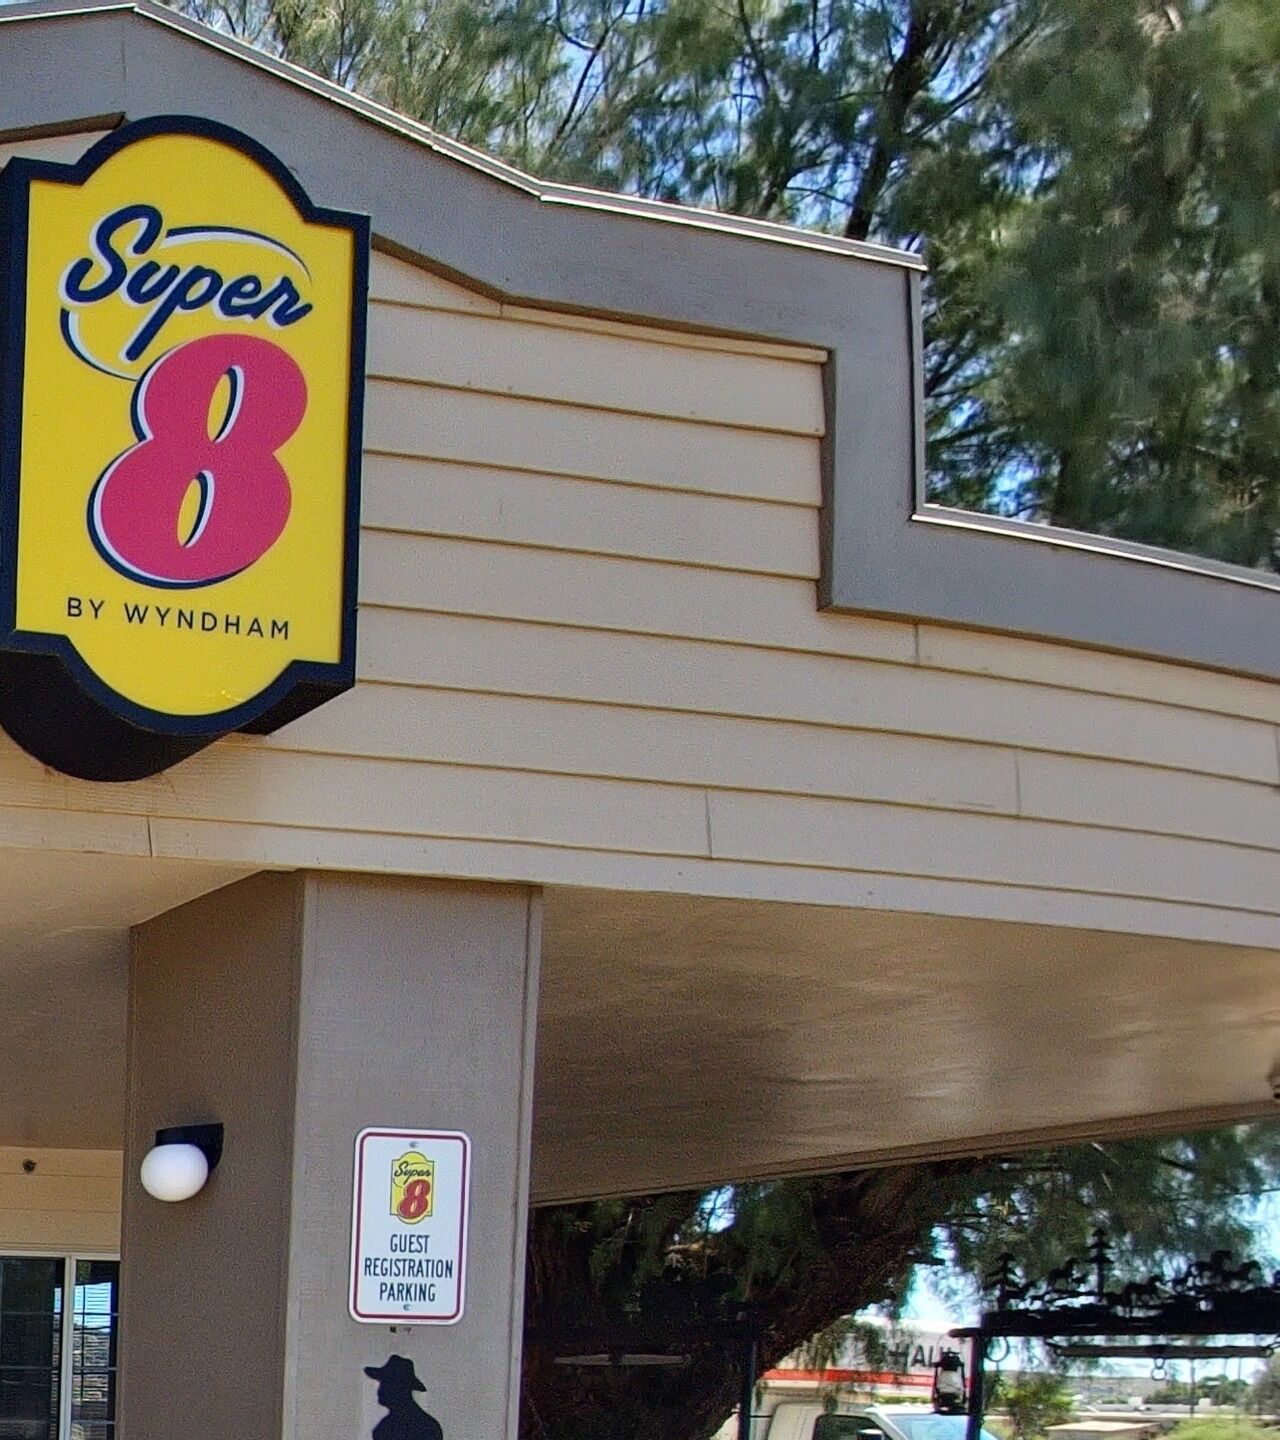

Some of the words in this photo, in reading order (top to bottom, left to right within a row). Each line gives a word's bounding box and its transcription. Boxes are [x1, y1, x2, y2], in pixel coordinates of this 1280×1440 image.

[62, 204, 313, 363] Super
[87, 333, 308, 590] 8
[66, 597, 105, 620] BY
[123, 602, 291, 641] WYNDHAM
[393, 1160, 432, 1186] Super
[397, 1178, 431, 1220] 8
[389, 1233, 430, 1255] GUEST
[363, 1257, 454, 1280] REGISTRATION
[378, 1282, 436, 1303] PARKING
